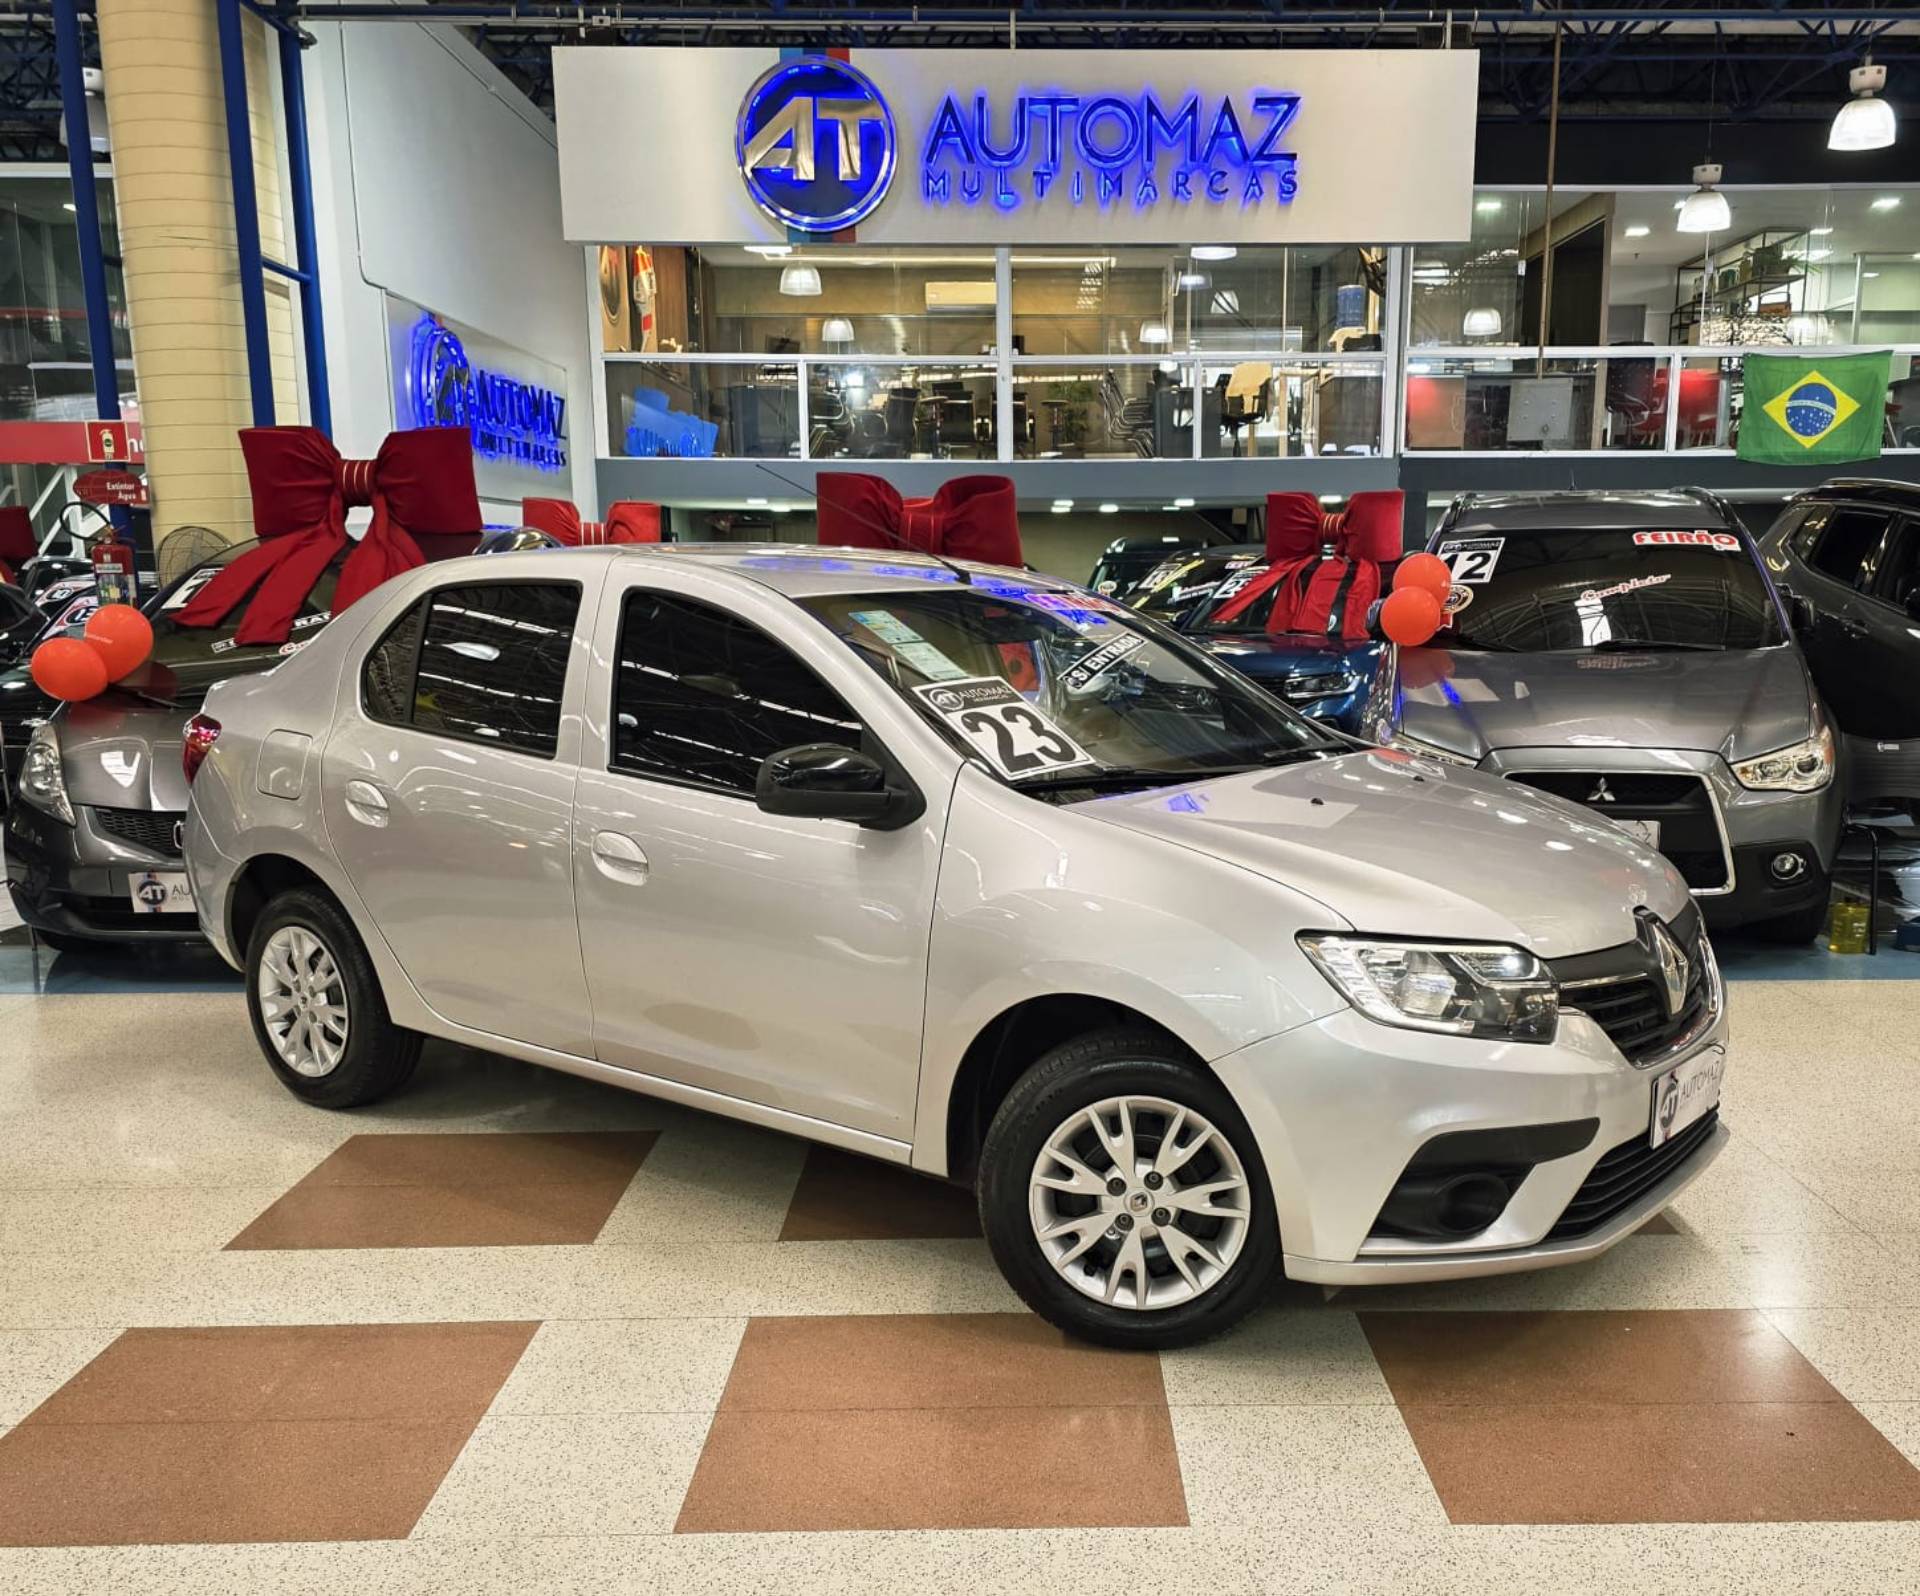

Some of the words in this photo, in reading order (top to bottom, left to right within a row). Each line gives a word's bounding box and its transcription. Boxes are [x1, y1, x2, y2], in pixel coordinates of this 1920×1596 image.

[744, 96, 884, 181] AT
[926, 94, 1301, 164] AUTOMAZ
[926, 169, 1298, 199] MULTIMARCAS
[476, 369, 567, 440] AUTOMAZ
[1634, 531, 1738, 546] FEIRÃO
[1083, 634, 1140, 671] ENTRADA
[959, 686, 1011, 699] AUTOMAZ
[960, 706, 1076, 773] 23
[139, 885, 165, 900] AT
